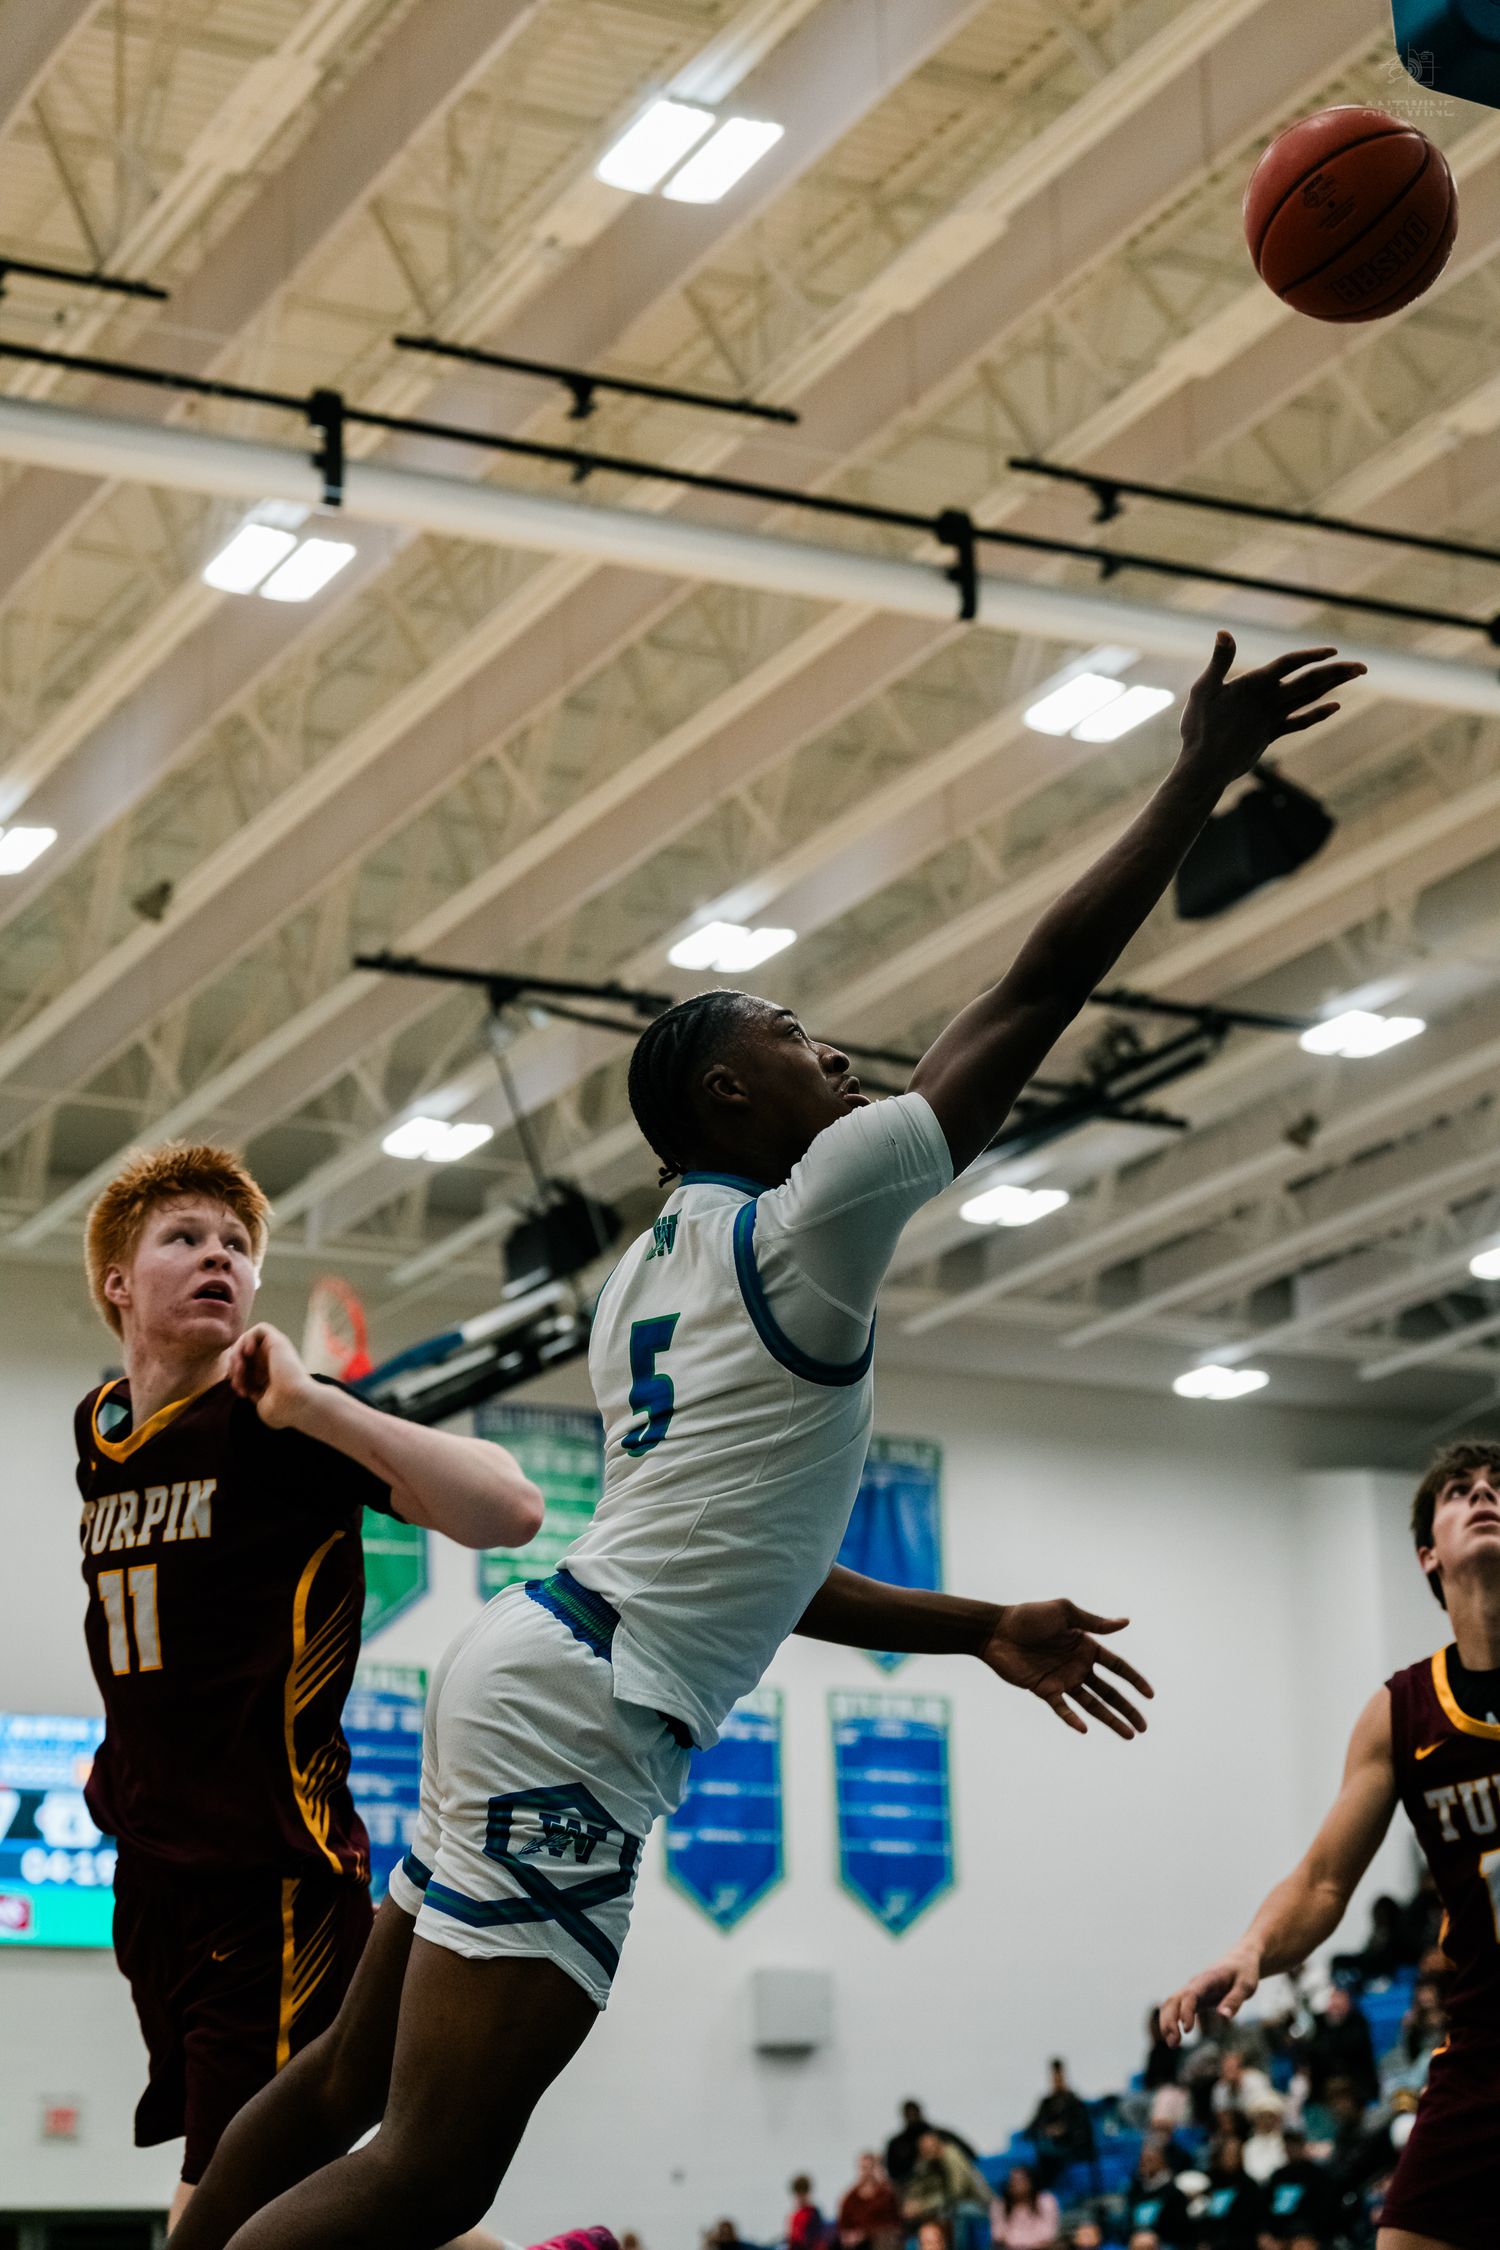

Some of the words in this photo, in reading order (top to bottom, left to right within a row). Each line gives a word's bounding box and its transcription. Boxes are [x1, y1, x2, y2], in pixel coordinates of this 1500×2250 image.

[621, 1312, 681, 1457] 5
[80, 1478, 217, 1555] TURPIN
[98, 1563, 163, 1676] 11
[1424, 1774, 1500, 1842] TU
